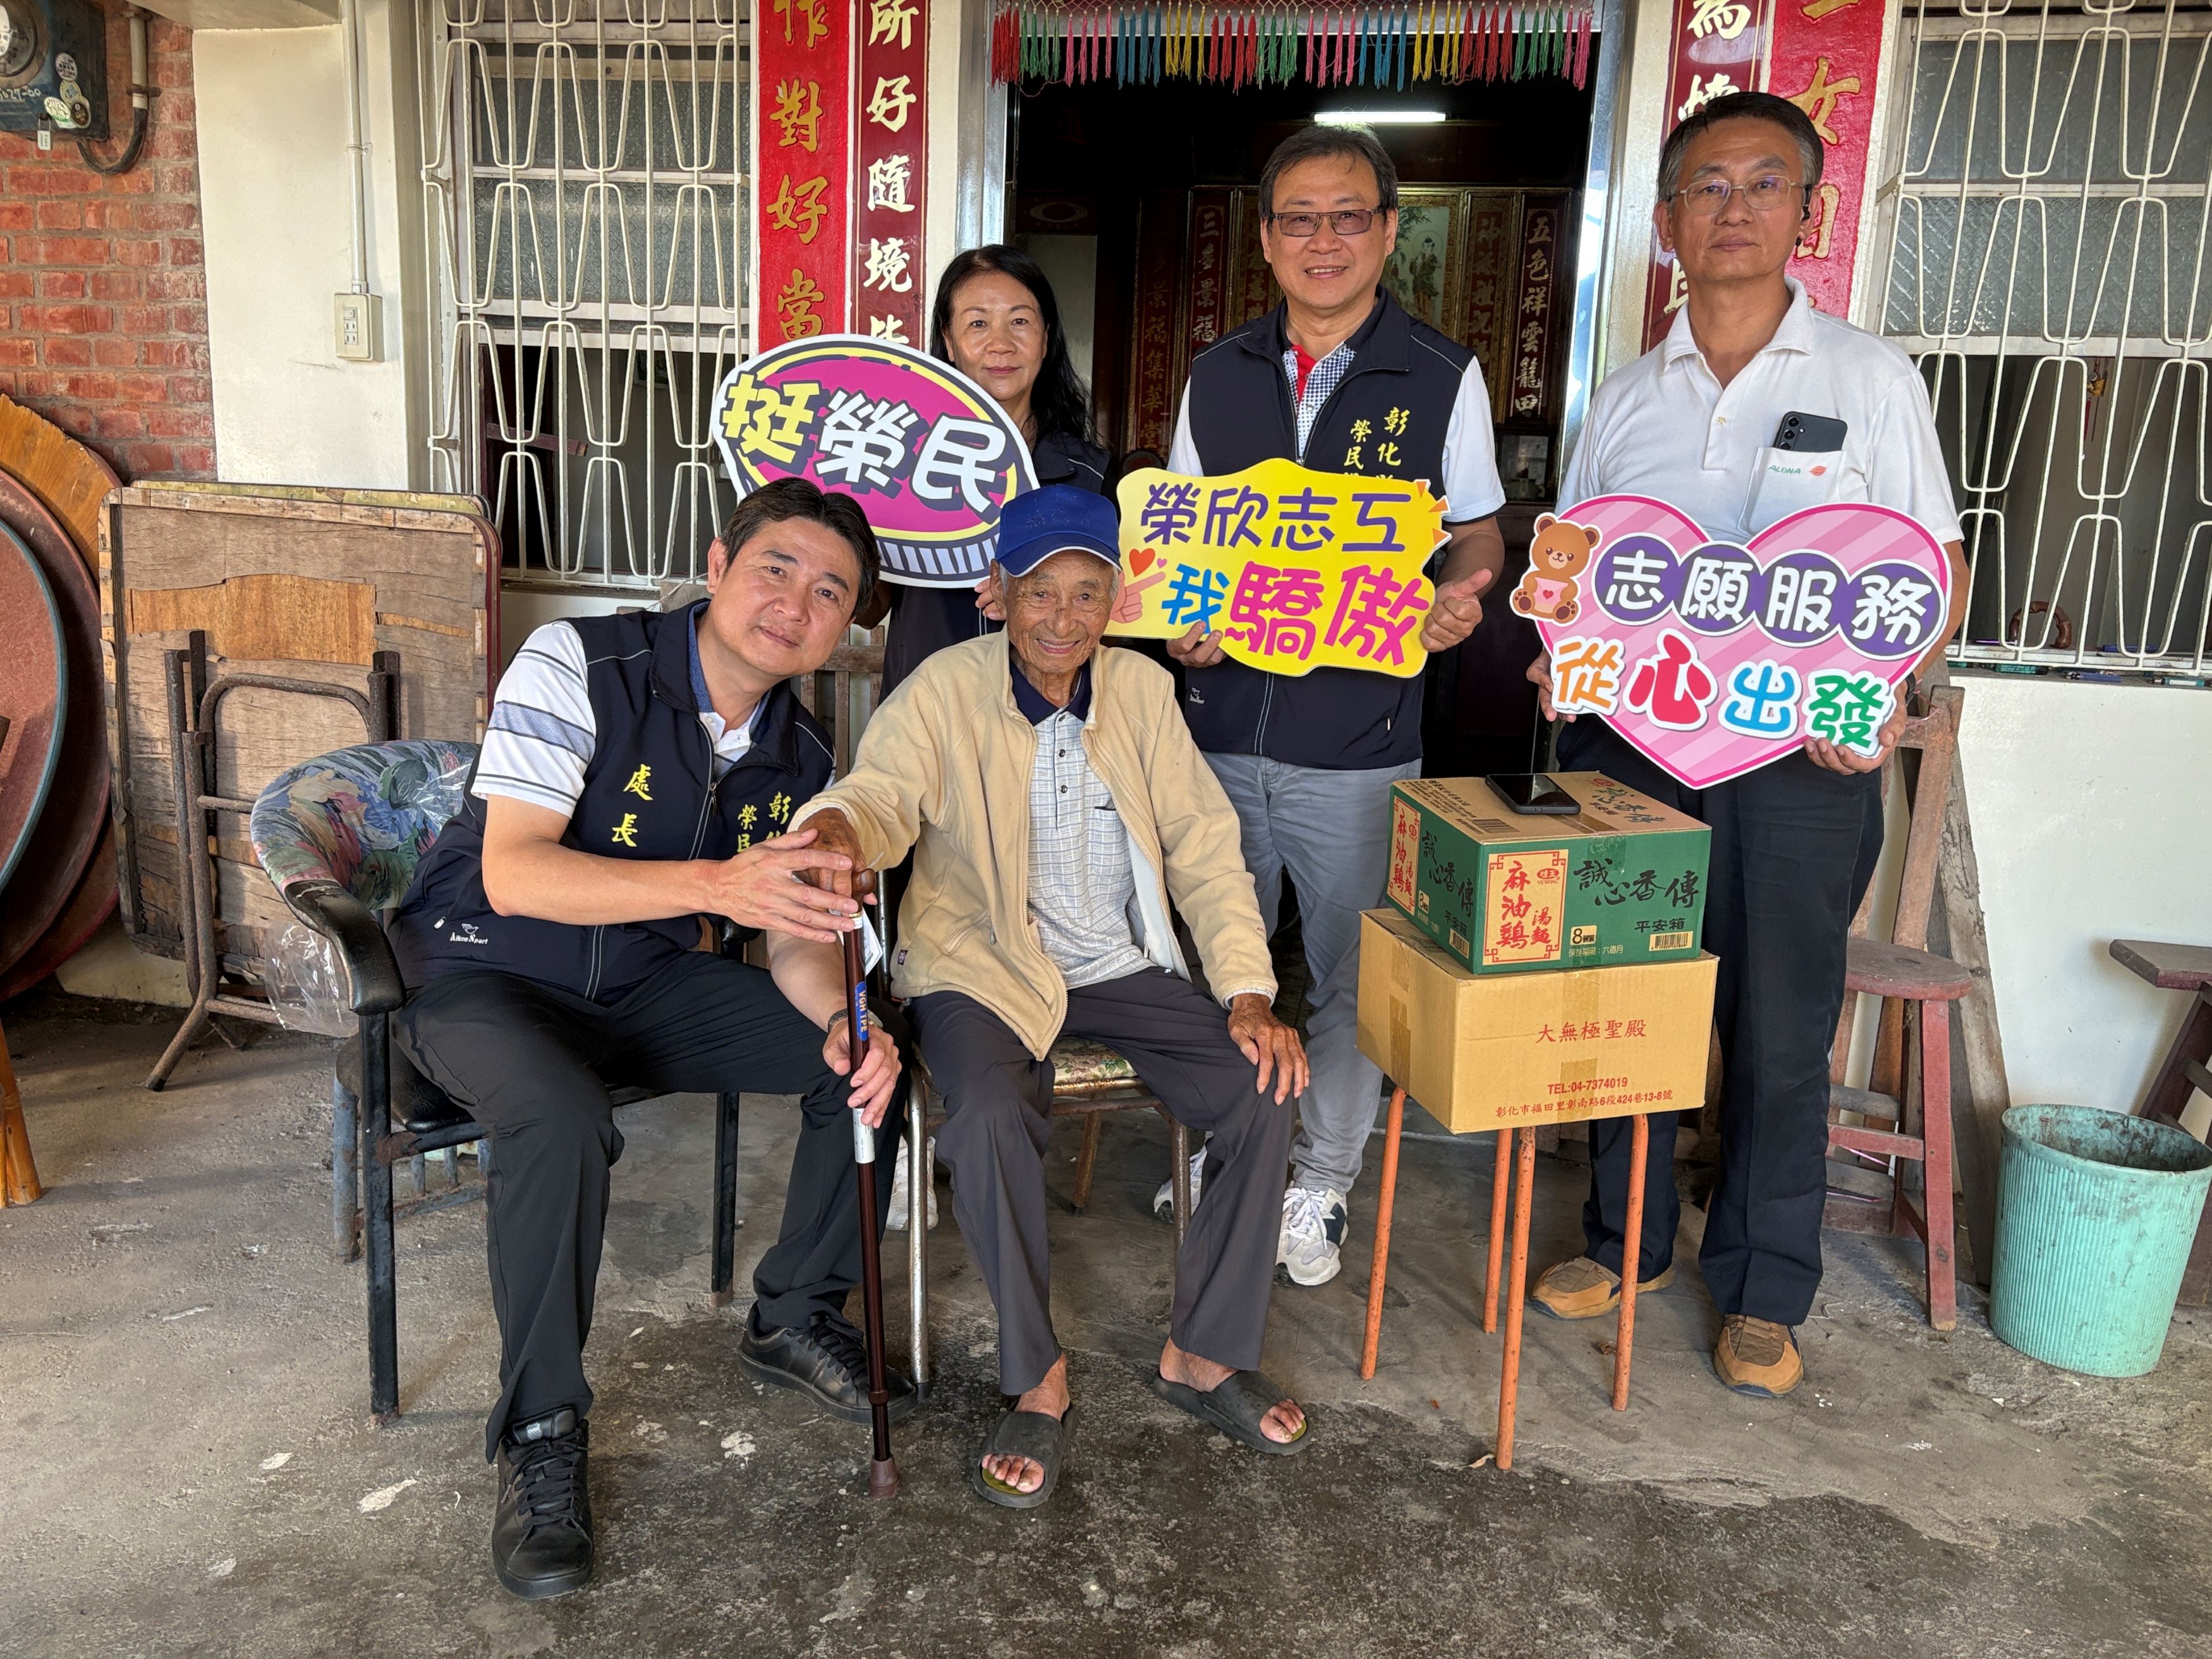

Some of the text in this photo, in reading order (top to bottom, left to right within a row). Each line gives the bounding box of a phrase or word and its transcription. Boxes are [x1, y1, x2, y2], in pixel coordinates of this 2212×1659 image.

[1140, 216, 1170, 449] 多景福集華堂
[721, 373, 1007, 514] 挺榮民
[1343, 419, 1373, 476] 榮民
[1376, 406, 1411, 479] 彰化
[1140, 482, 1412, 553] 榮欣志工
[1161, 561, 1430, 666] 我驕傲
[1605, 549, 1933, 645] 志願服務
[1556, 634, 1883, 750] 從心出發
[611, 763, 654, 848] 處長
[1573, 858, 1699, 908] 誠心香傳
[1634, 918, 1686, 933] 平安箱
[1535, 1019, 1647, 1044] 大無極聖殿
[1547, 1076, 1628, 1095] TEL:04-7374019
